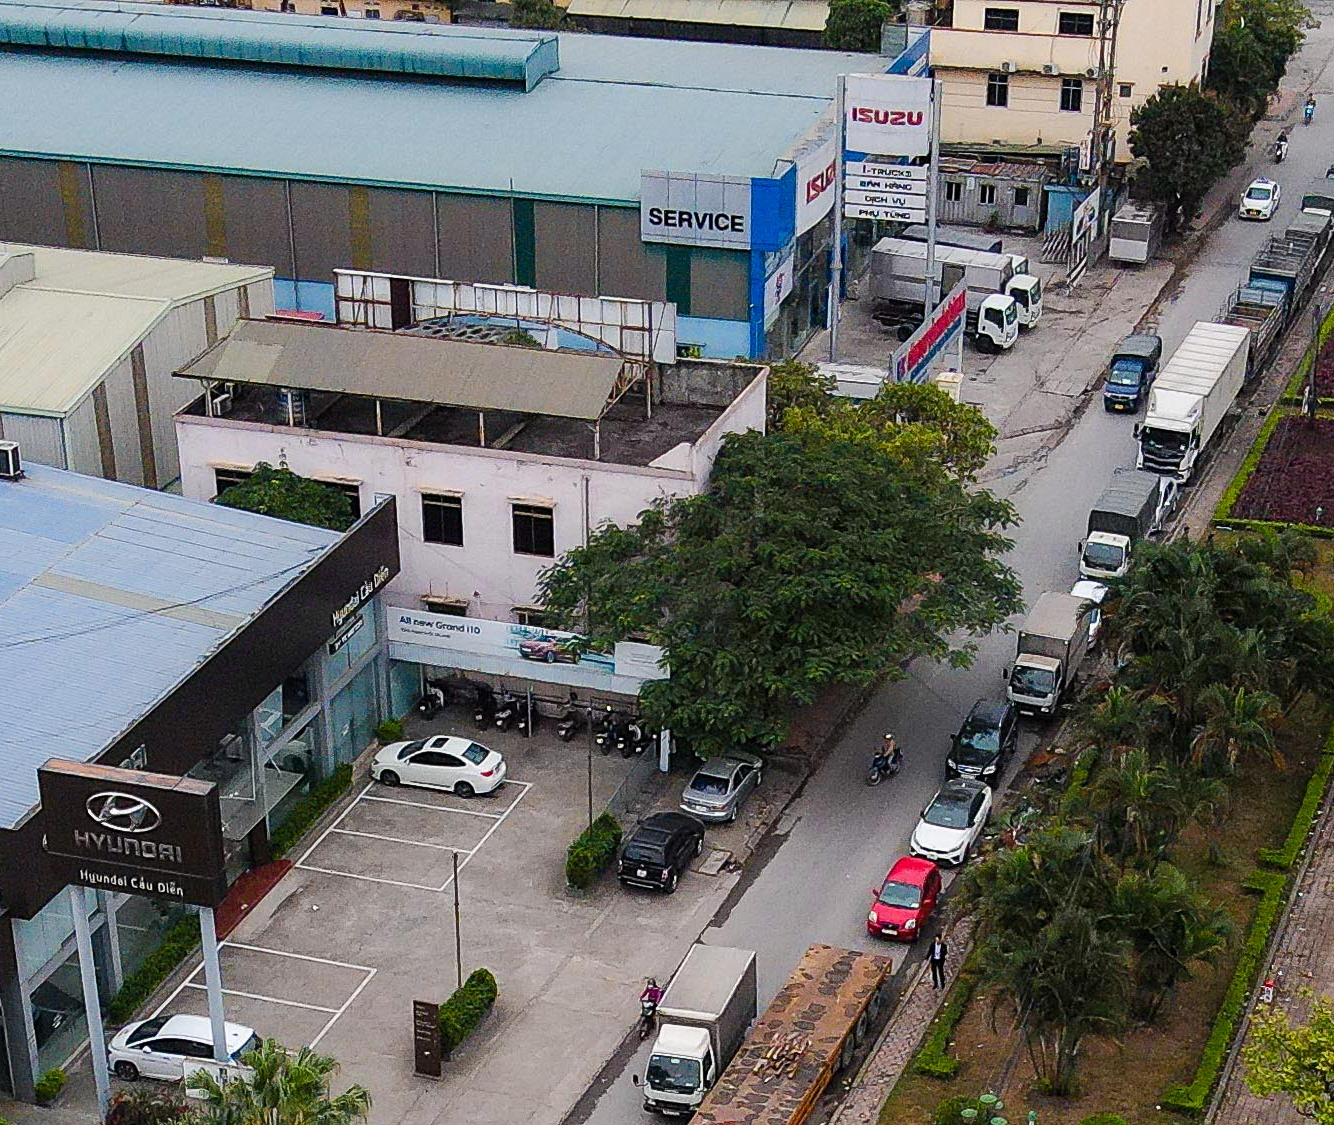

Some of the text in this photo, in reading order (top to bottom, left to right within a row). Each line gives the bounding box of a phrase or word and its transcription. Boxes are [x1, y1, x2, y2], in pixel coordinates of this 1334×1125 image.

[852, 107, 924, 126] ISUZU
[649, 207, 744, 232] SERVICE
[399, 615, 412, 625] All
[435, 621, 465, 633] Grand
[74, 829, 183, 864] HYUNDAI
[80, 869, 127, 887] Hyundai
